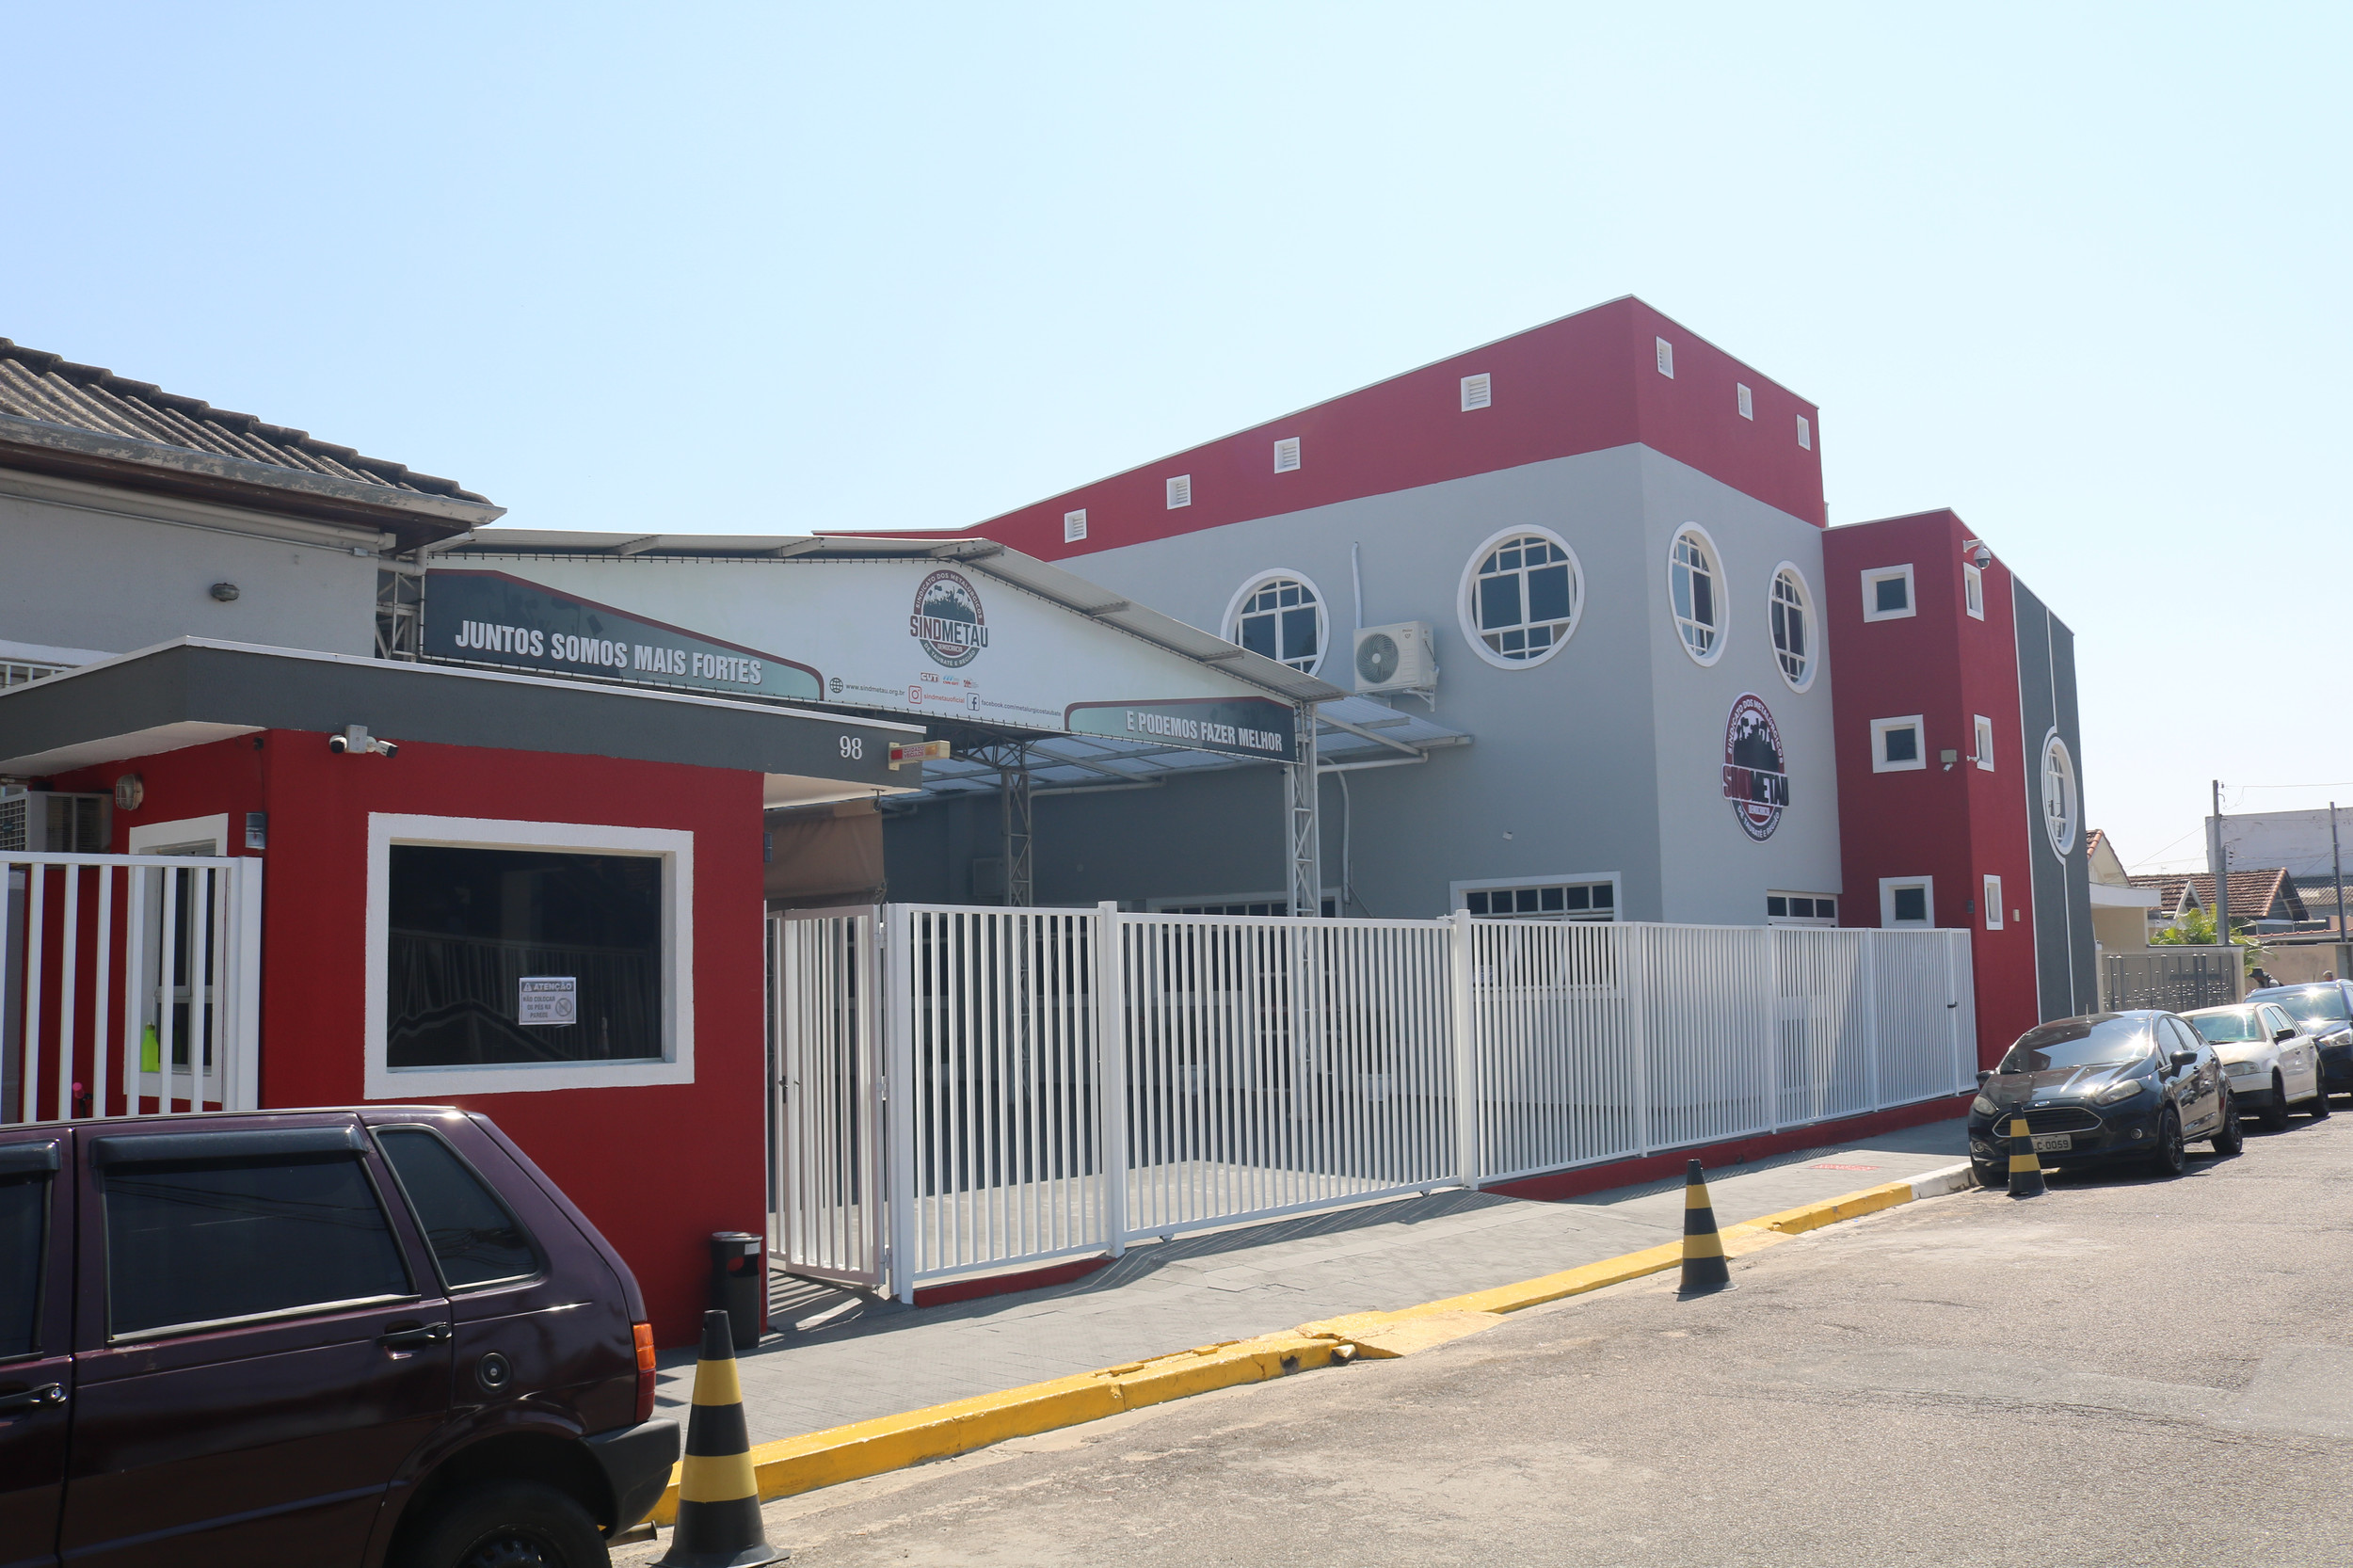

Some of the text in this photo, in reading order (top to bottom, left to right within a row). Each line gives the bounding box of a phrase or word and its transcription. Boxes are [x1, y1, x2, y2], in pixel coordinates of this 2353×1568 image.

[916, 575, 936, 609] SINDICATO
[910, 615, 988, 648] SINDMETAU
[456, 620, 762, 685] JUNTOS SOMOS MAIS FORTES
[846, 683, 905, 696] www.sindmetau.org.br
[920, 673, 938, 682] CUT
[924, 694, 965, 703] sindmetauoficial
[1126, 711, 1283, 752] E PODEMOS FAZER MELHOR
[840, 735, 863, 760] 98
